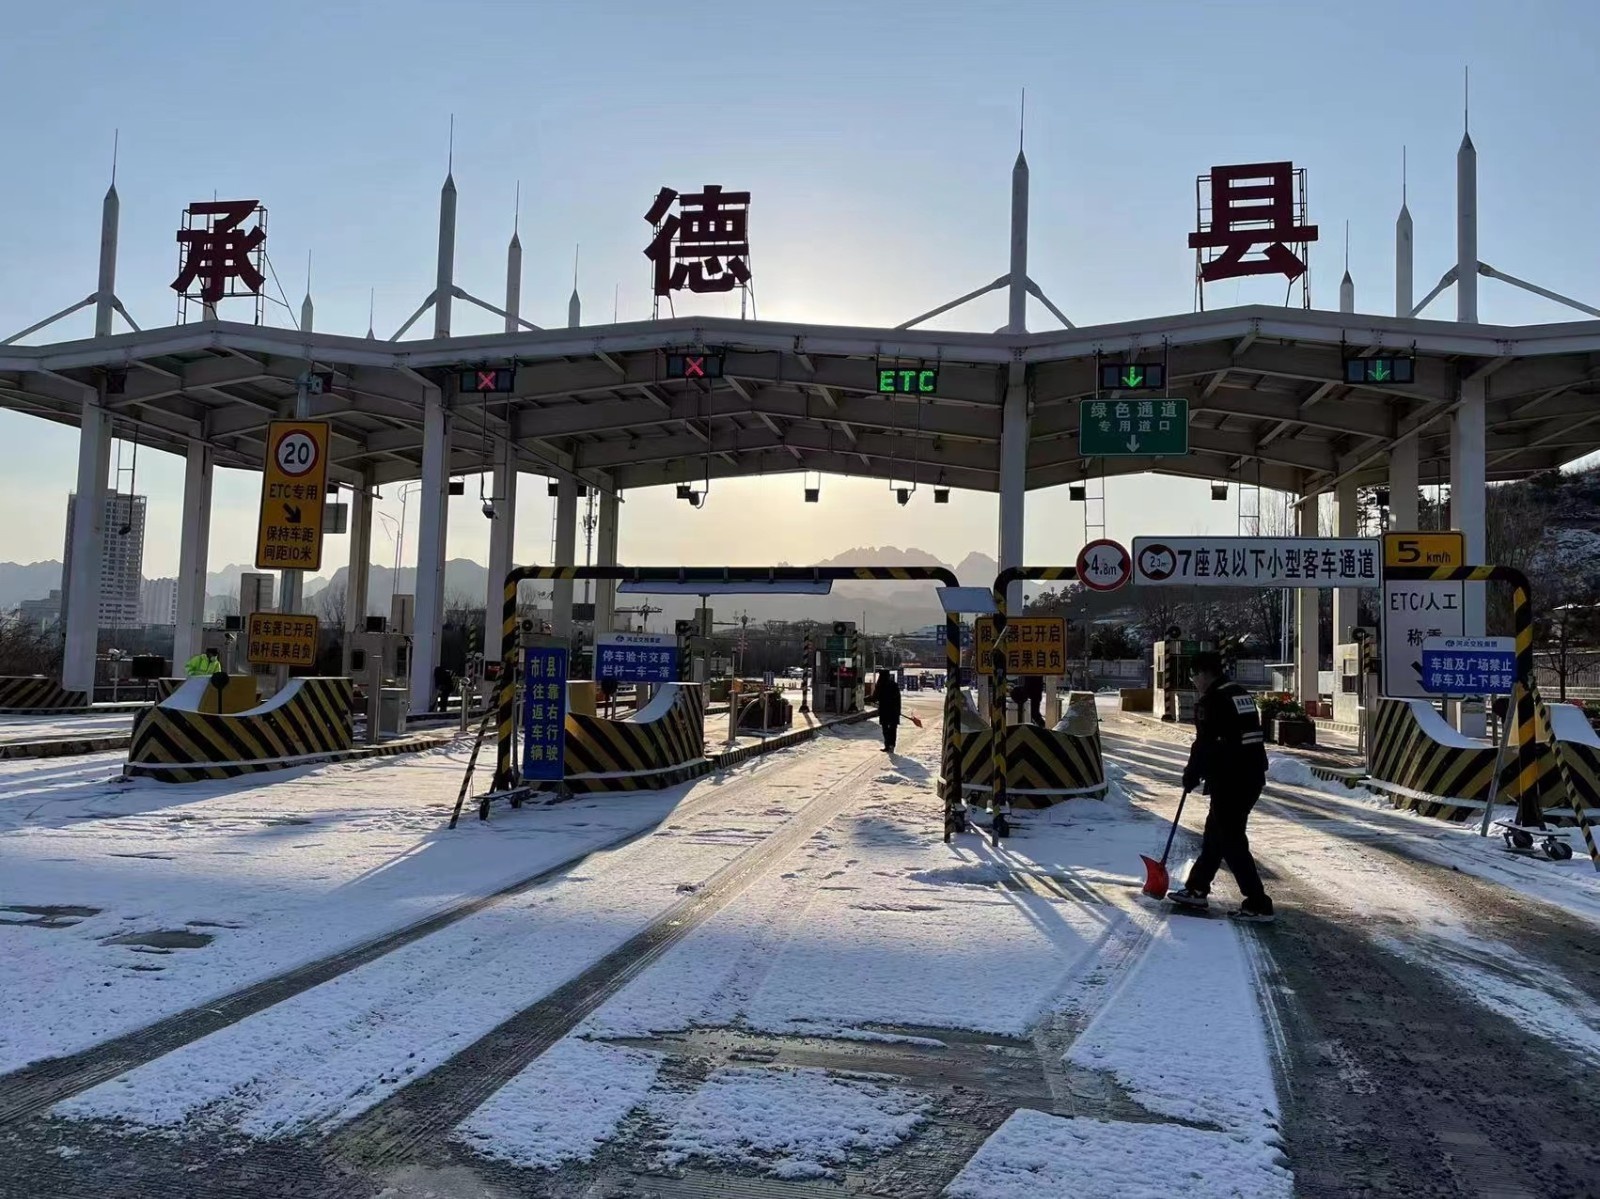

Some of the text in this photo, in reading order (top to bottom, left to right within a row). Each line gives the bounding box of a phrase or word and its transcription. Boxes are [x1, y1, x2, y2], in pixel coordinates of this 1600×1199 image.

[880, 371, 934, 391] ETC
[1091, 402, 1177, 418] 绿色通道
[1099, 420, 1170, 432] 专用道口
[284, 442, 310, 465] 20
[269, 484, 318, 500] ETC专用
[266, 526, 314, 542] 保持车距
[264, 545, 312, 561] 间距10米
[1398, 541, 1451, 563] 5 km/h
[1177, 548, 1376, 579] 7座及以下小型客车通道
[1390, 592, 1457, 611] ETC/人工
[980, 624, 1061, 643] 阻器已开启
[603, 650, 670, 664] 停车验卡交费
[981, 649, 1061, 668] 闯后果自负
[1431, 658, 1512, 672] 车道及广场禁止
[602, 665, 670, 678] 栏杆一车一落
[1431, 674, 1512, 688] 停车及上下乘客
